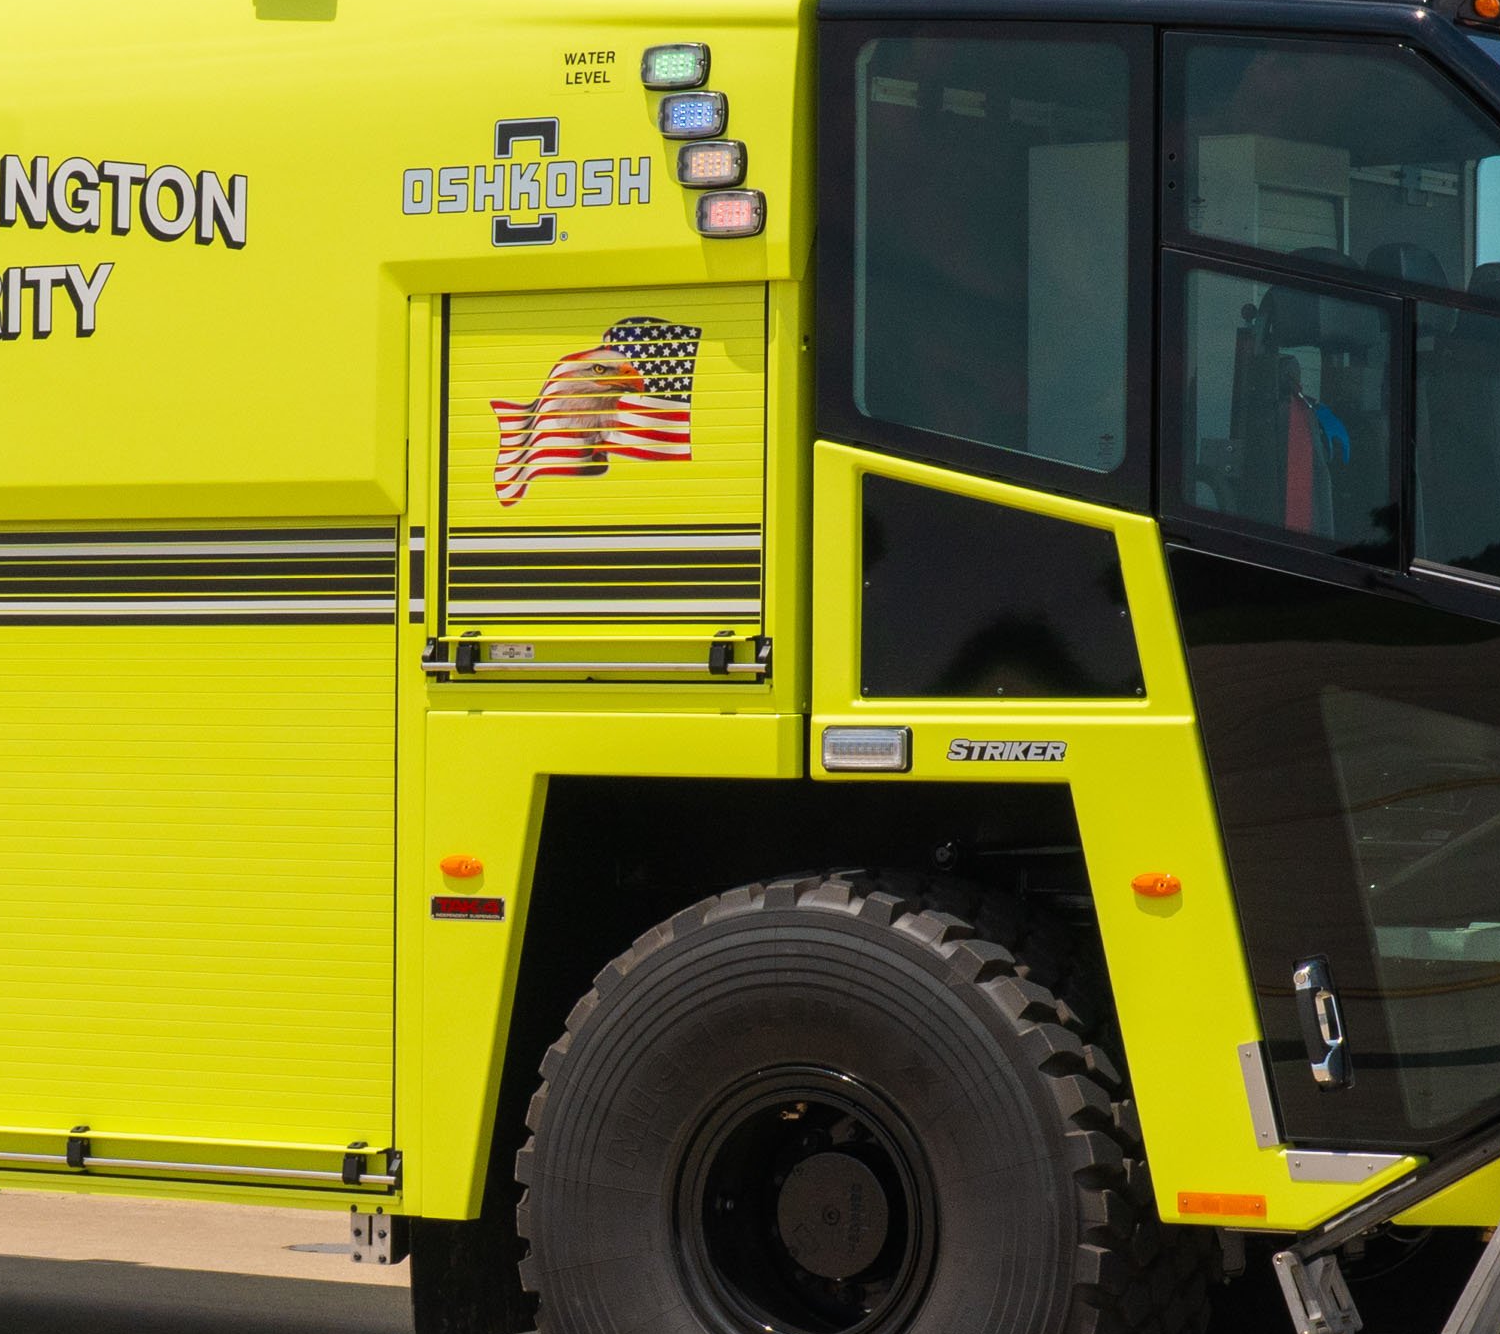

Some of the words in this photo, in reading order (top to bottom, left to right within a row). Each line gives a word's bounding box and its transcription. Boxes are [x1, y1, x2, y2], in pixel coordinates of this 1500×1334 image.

[564, 50, 616, 66] WATER
[565, 70, 611, 85] LEVEL
[402, 156, 652, 215] OSHKOSH
[946, 738, 1069, 763] STRIKER
